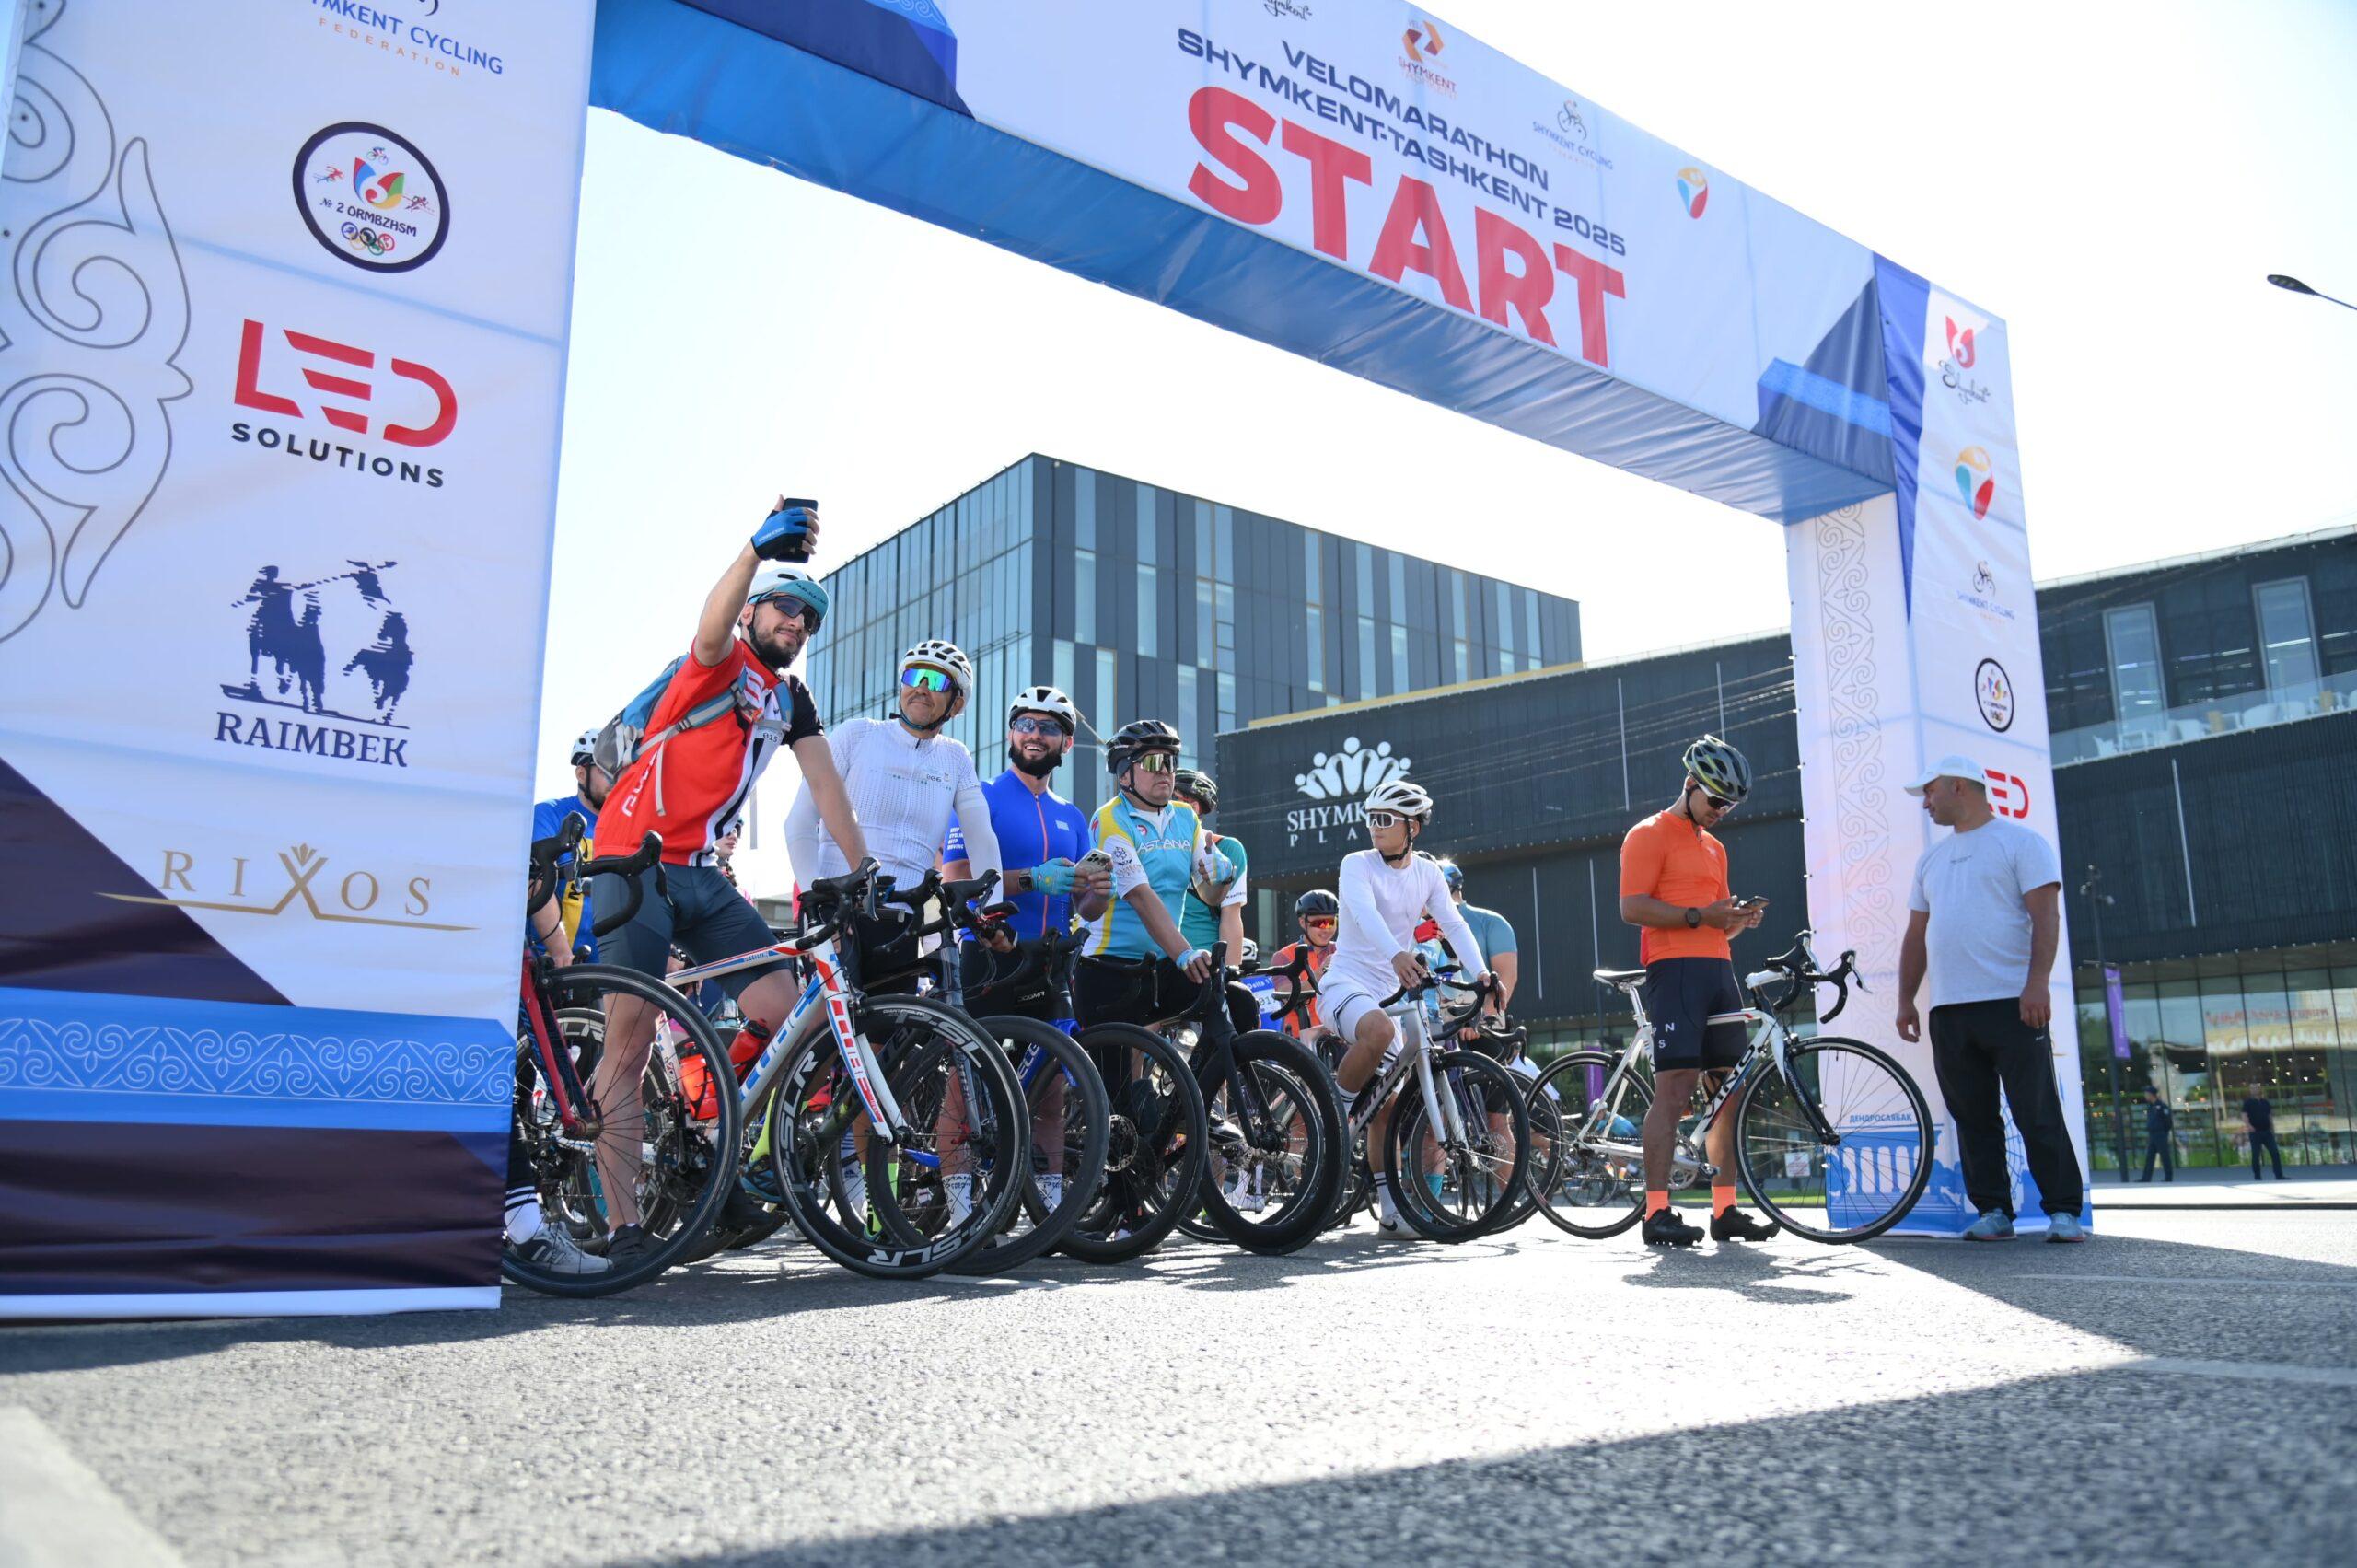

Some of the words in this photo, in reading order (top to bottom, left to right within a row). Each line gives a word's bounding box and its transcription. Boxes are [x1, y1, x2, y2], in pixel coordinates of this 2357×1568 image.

[312, 0, 403, 34] MKENT
[410, 26, 503, 75] CYCLING
[319, 17, 460, 77] FEDERATION
[1398, 56, 1457, 92] SHYMKENT
[1282, 40, 1550, 191] VELOMARATHON
[1178, 28, 1548, 219] SHYMKENT-TASHKENT
[1553, 207, 1626, 257] 2025
[1578, 145, 1613, 170] CYCLING
[336, 202, 344, 213] 2
[347, 205, 417, 237] ORMBZHSM
[1187, 86, 1627, 368] START
[234, 319, 458, 447] LED
[231, 423, 444, 488] SOLUTIONS
[214, 712, 409, 767] RAIMBEK
[1287, 802, 1367, 832] SHYMK
[1985, 768, 2030, 819] ED
[1137, 839, 1191, 854] ASTANA
[1290, 827, 1359, 847] PLA
[157, 843, 431, 919] RIXOS
[1658, 1039, 1666, 1049] S
[1665, 1022, 1675, 1032] N
